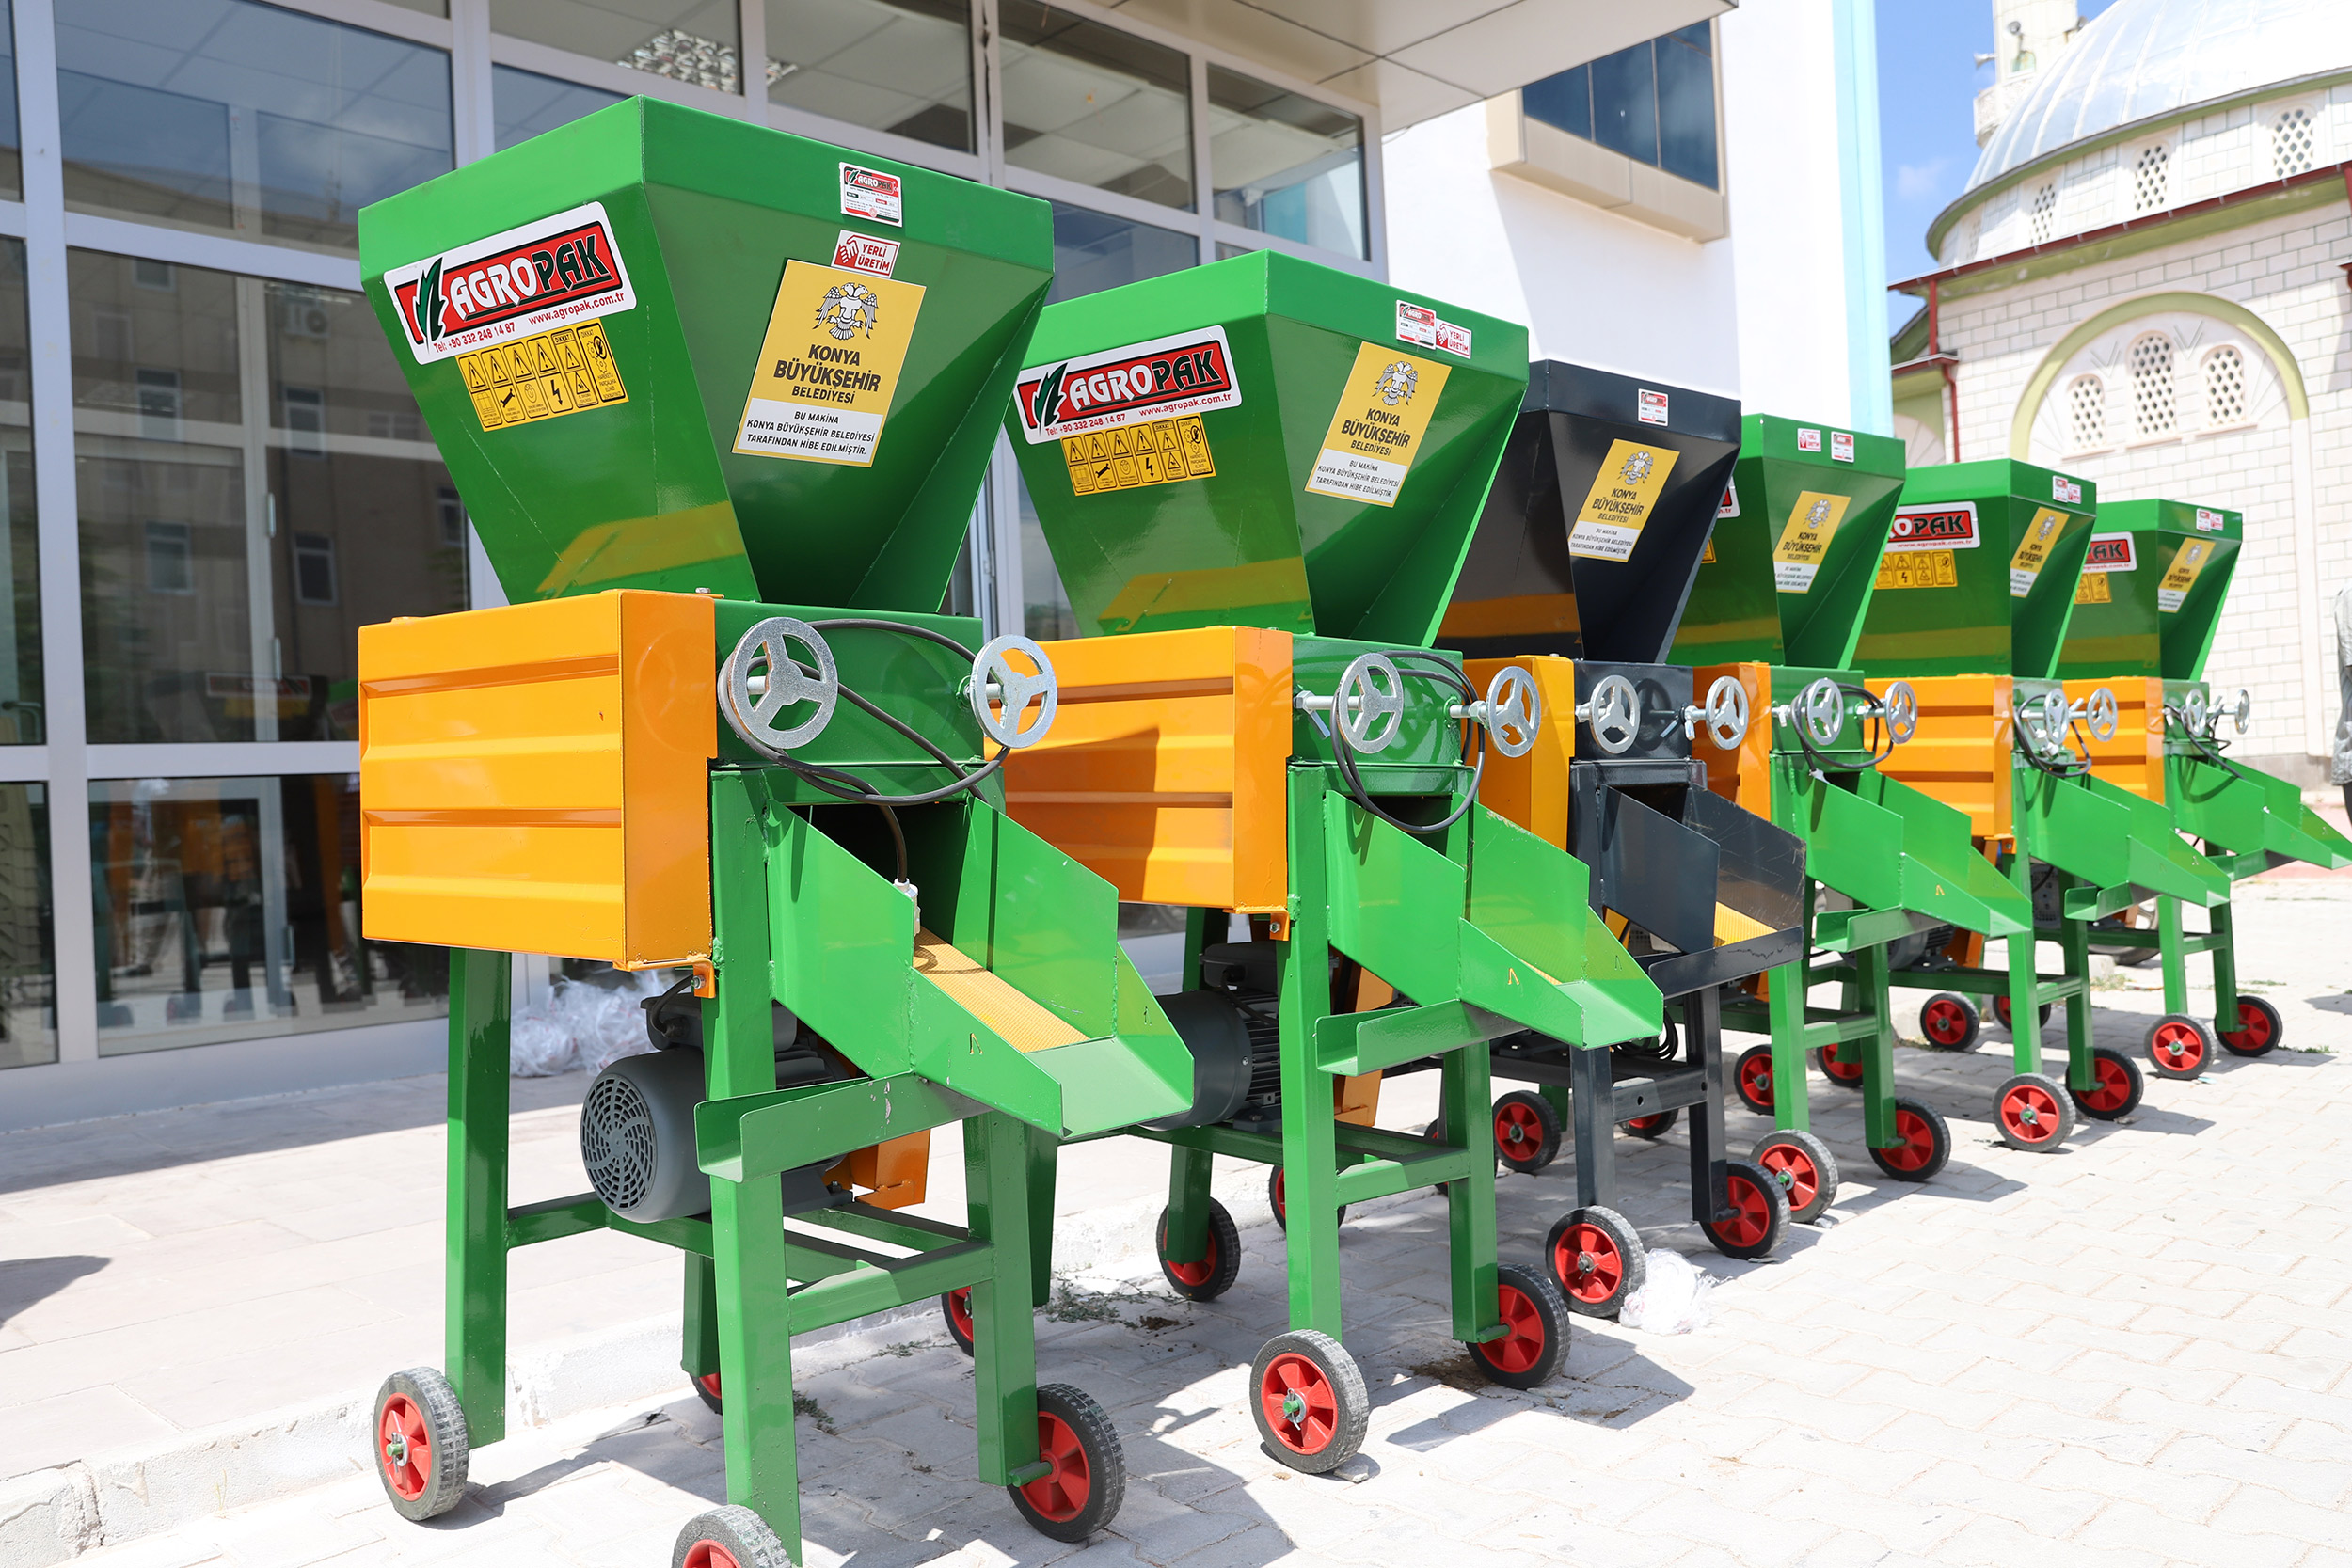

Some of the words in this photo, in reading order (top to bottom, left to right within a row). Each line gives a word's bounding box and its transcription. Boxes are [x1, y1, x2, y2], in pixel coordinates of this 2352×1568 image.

[858, 175, 892, 191] AGROPAK
[863, 243, 888, 258] YERLİ
[858, 253, 890, 271] ÜRETİM
[450, 234, 610, 322] AGROPAK
[434, 342, 447, 354] Tel:
[448, 336, 462, 349] +90
[463, 332, 477, 346] 332
[478, 328, 493, 342] 248
[494, 325, 505, 337] 14
[505, 321, 516, 334] 87
[528, 292, 626, 325] www.agropak.com.tr
[808, 343, 861, 367] KONYA
[773, 357, 882, 392] BÜYÜKŞEHİR
[1069, 349, 1222, 412] AGROPAK
[791, 385, 856, 404] BELEDİYESİ
[794, 410, 805, 421] BU
[807, 412, 839, 424] MAKİNA
[1045, 426, 1059, 436] Tel:
[1059, 423, 1073, 434] +90
[1073, 420, 1089, 431] 332
[1089, 418, 1104, 428] 248
[1104, 415, 1115, 426] 14
[1116, 413, 1126, 423] 87
[1138, 392, 1232, 417] www.agropak.com.tr
[1365, 408, 1401, 427] KONYA
[746, 420, 774, 432] KONYA
[776, 421, 829, 437] BÜYÜKŞEHİR
[830, 429, 876, 442] BELEDİYESİ
[1341, 418, 1411, 448] BÜYÜKŞEHİR
[746, 433, 798, 448] TARAFINDAN
[799, 437, 818, 450] HİBE
[820, 441, 866, 456] EDİLMİŞTİR.
[1350, 439, 1392, 456] BELEDİYESİ
[1317, 465, 1336, 475] KONYA
[1336, 468, 1371, 482] BÜYÜKŞEHİR
[1370, 475, 1400, 487] BELEDİYESİ
[1349, 459, 1357, 467] BU
[1358, 461, 1378, 472] MAKİNA
[1316, 476, 1348, 489] TARAFINDAN
[1611, 488, 1637, 500] KONYA
[1592, 496, 1645, 516] BÜYÜKŞEHİR
[1889, 515, 1965, 539] OPAK
